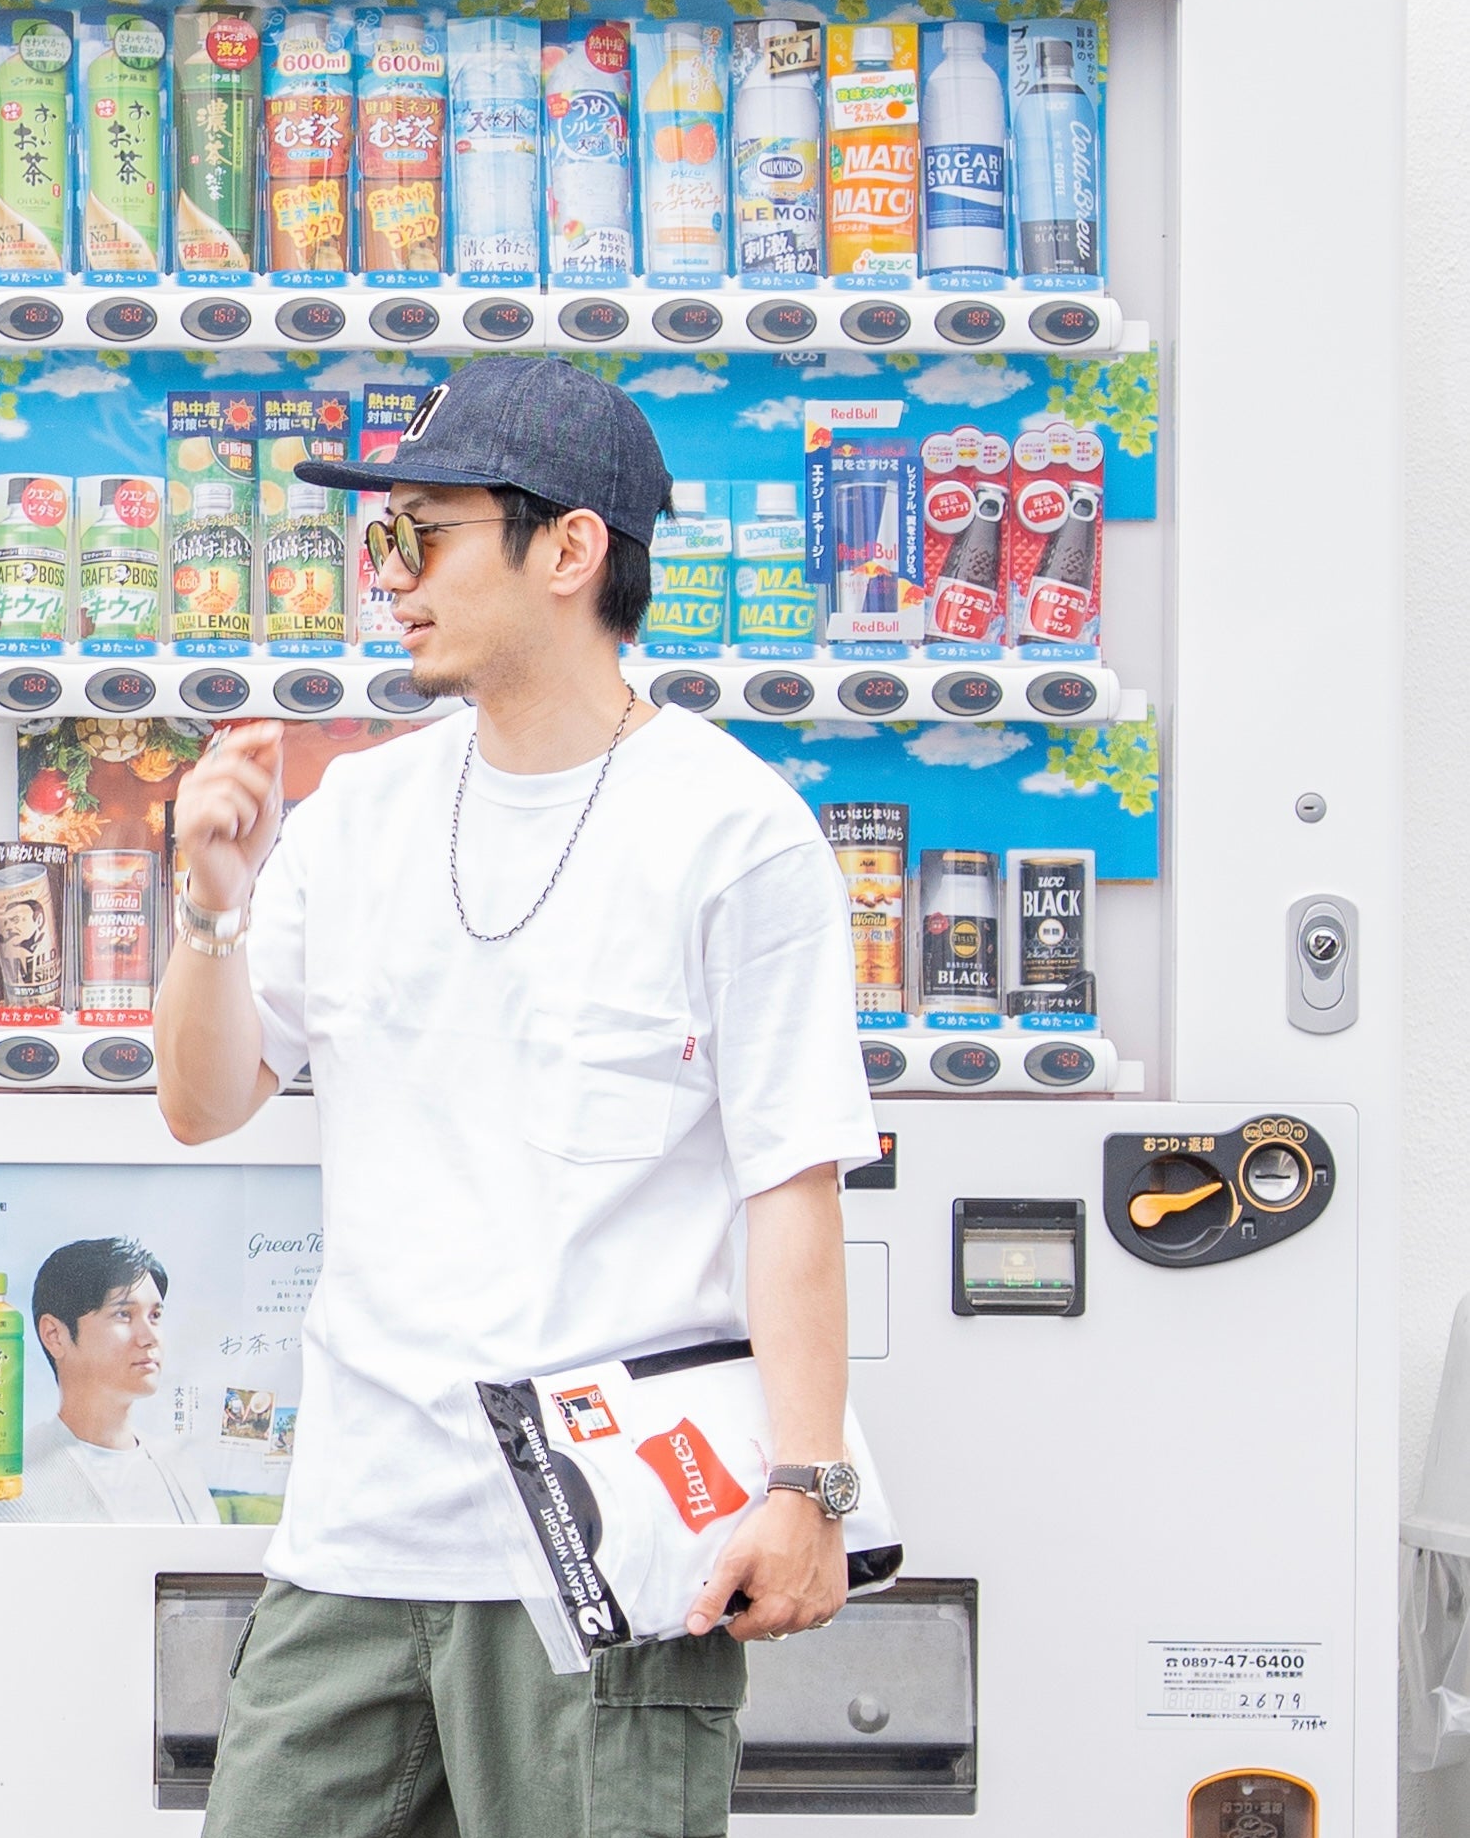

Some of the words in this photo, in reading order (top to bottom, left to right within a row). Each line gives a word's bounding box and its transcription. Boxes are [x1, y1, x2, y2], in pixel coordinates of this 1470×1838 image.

[589, 37, 625, 52] 熱中症
[283, 53, 346, 72] 600ml
[378, 55, 441, 74] 600ml
[594, 51, 623, 68] 対策!
[1010, 25, 1031, 97] ブラック
[211, 73, 240, 83] 伊藤園
[271, 97, 346, 113] 健康ミネラル
[366, 99, 441, 115] 健康ミネラル
[571, 99, 609, 121] うめ
[844, 102, 884, 114] ビタミン
[467, 111, 527, 133] 天然水
[853, 111, 887, 123] みかん
[274, 113, 344, 148] むぎ茶
[369, 115, 439, 150] むぎ茶
[760, 158, 802, 175] WILKINSON
[927, 153, 1002, 171] POCARI
[928, 169, 999, 186] SWEAT
[742, 207, 817, 223] LEMON
[1034, 232, 1071, 244] BLACK
[183, 242, 229, 259] 体脂肪
[868, 259, 913, 272] ビタミンC
[172, 399, 220, 417] 熱中症
[265, 399, 313, 417] 熱中症
[368, 393, 416, 411] 熱中症
[831, 408, 853, 420] Red
[856, 407, 878, 420] Bull
[172, 417, 224, 432] 対策にも!
[265, 417, 316, 432] 対策にも!
[218, 441, 252, 457] 自販機
[311, 441, 344, 457] 自販機
[939, 494, 959, 507] 元気
[1033, 495, 1053, 507] 元気
[28, 504, 63, 518] ビタミン
[120, 505, 155, 519] ビタミン
[838, 542, 868, 561] Red
[39, 567, 65, 587] BOSS
[80, 568, 109, 586] CRAFT
[131, 568, 157, 588] BOSS
[944, 589, 992, 612] オロナミン
[1038, 589, 1086, 612] オロナミン
[959, 608, 972, 620] C
[1054, 608, 1066, 620] C
[198, 615, 250, 631] LEMON
[294, 615, 343, 631] LEMON
[853, 621, 875, 633] Red
[877, 621, 899, 633] Bull
[949, 619, 977, 634] ドリンク
[1043, 619, 1071, 634] ドリンク
[829, 808, 901, 822] いいはじまりは
[828, 823, 904, 842] 上質な休憩から
[94, 894, 139, 910] Wonda
[1023, 889, 1081, 918] BLACK
[88, 914, 145, 926] MORNING
[852, 913, 886, 927] Wonda
[97, 926, 136, 938] SHOT
[938, 970, 990, 986] BLACK
[1143, 1136, 1215, 1153] おつり・返却
[248, 1232, 305, 1259] Green
[306, 1232, 324, 1253] Te
[219, 1332, 302, 1355] お茶で
[520, 1416, 551, 1474] T-SHIRTS
[669, 1432, 716, 1518] Hanes
[544, 1474, 572, 1523] POCKET
[540, 1508, 569, 1560] WEIGHT
[567, 1525, 590, 1560] NECK
[562, 1561, 590, 1607] HEAVY
[580, 1560, 602, 1601] CREW
[578, 1600, 615, 1636] 2
[1181, 1654, 1305, 1669] 0897-47-6400
